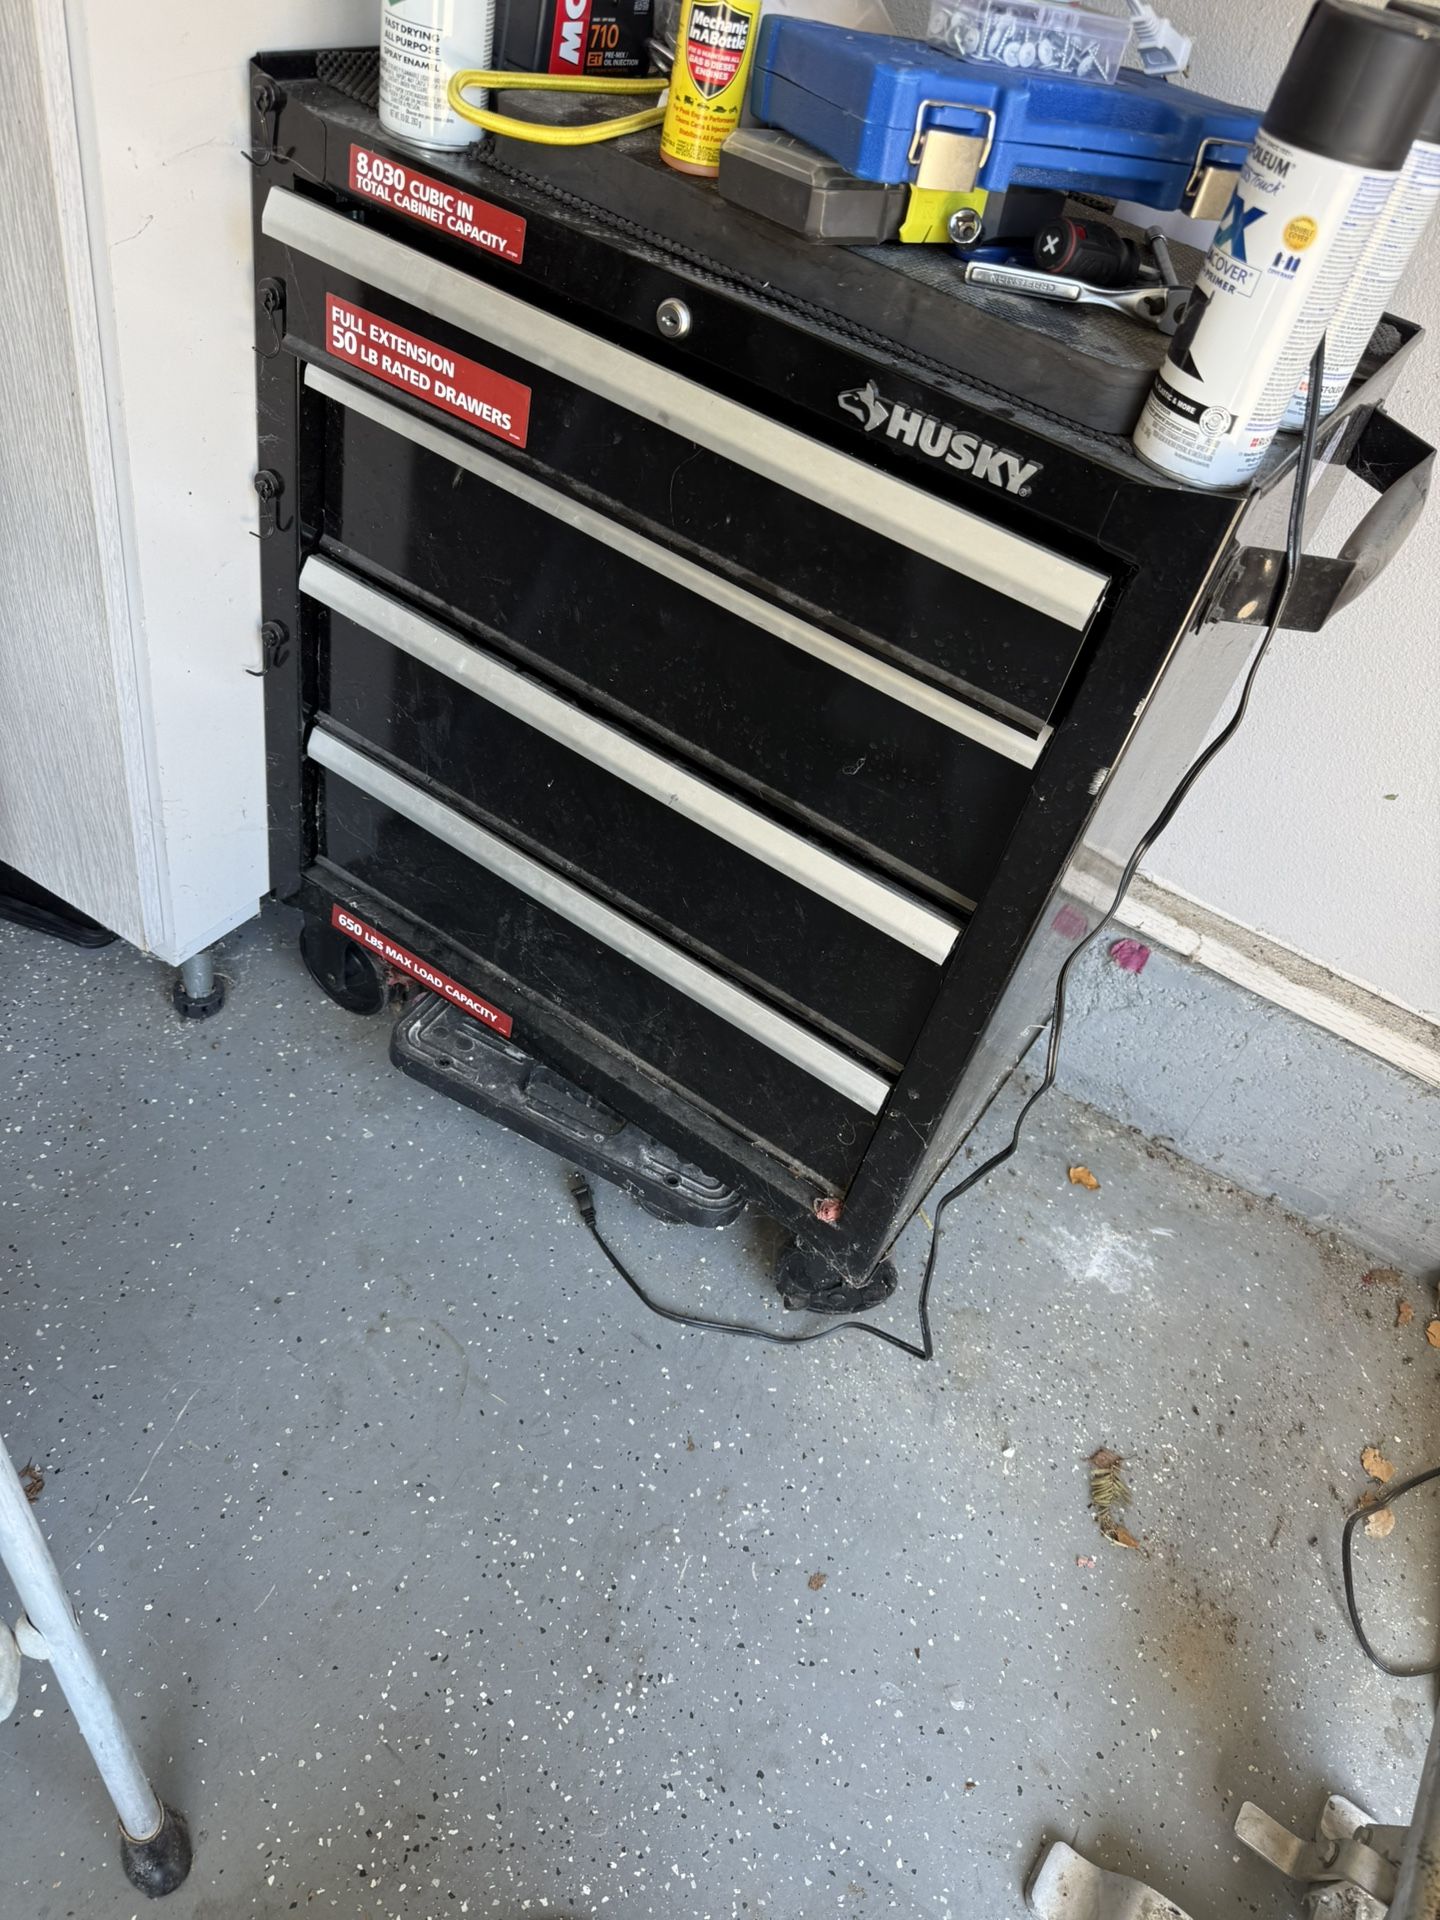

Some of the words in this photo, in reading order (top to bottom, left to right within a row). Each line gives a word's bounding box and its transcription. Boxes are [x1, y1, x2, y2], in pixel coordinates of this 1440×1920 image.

[384, 16, 400, 32] FAST
[400, 28, 440, 43] DRYING
[693, 9, 749, 34] Mechanic
[384, 29, 398, 43] ALL
[396, 36, 440, 55] PURPOSE
[591, 23, 619, 49] 710
[384, 46, 402, 61] SPRAY
[403, 56, 440, 72] ENAML
[588, 53, 602, 65] 2T
[689, 54, 704, 66] GAS
[711, 60, 736, 72] DIESEL
[694, 65, 729, 81] ENGINES
[356, 151, 405, 191] 8,030
[409, 180, 454, 213] CUBIC
[456, 199, 474, 222] IN
[355, 174, 391, 202] TOTAL
[394, 193, 445, 225] CABINET
[446, 216, 507, 252] CAPACITY
[1213, 187, 1268, 264] X
[1205, 271, 1237, 295] PRIMER
[331, 305, 367, 337] FULL
[369, 323, 455, 378] EXTENSION
[332, 325, 357, 355] 50
[360, 344, 378, 366] LB
[382, 354, 431, 391] RATED
[434, 380, 512, 431] DRAWERS
[1177, 399, 1197, 416] MORE
[885, 402, 1041, 495] HUSKY
[338, 913, 362, 936] 650
[364, 931, 384, 951] LBS
[385, 945, 412, 969] MAX
[413, 963, 443, 988] LOAD
[445, 985, 498, 1022] CAPACITY
